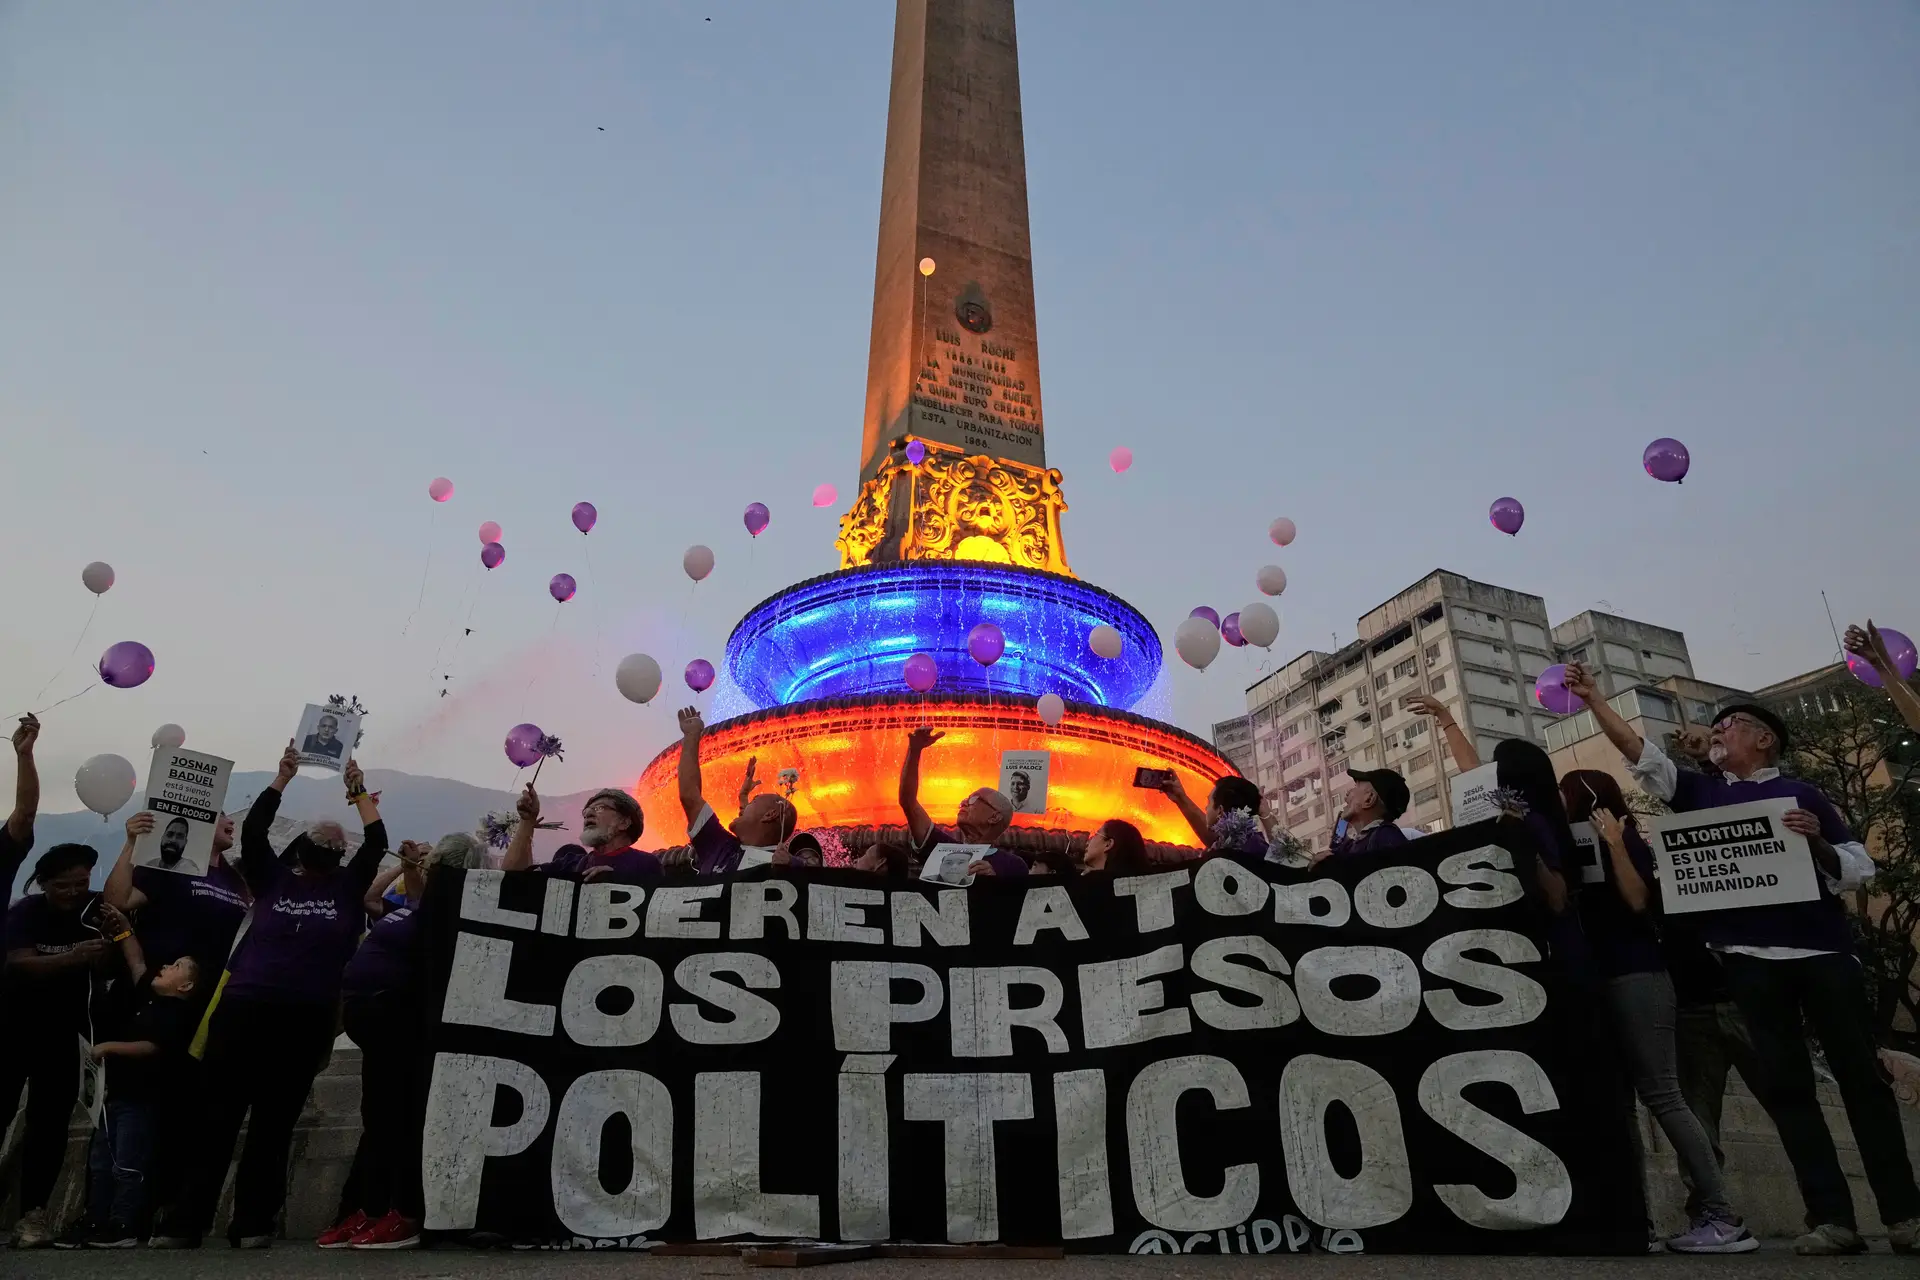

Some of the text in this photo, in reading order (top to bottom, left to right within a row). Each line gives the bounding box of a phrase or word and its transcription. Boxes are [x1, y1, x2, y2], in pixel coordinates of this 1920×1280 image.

[936, 329, 1016, 362] LUIS ROCHE
[949, 376, 992, 397] DISTRITO
[952, 366, 1025, 391] MUNICIPALIDAD
[929, 383, 957, 401] QUIEN
[963, 396, 988, 409] SUPO
[994, 402, 1025, 417] CREAR
[1031, 409, 1038, 421] Y
[922, 411, 1033, 446] ESTA URBANIZACION
[978, 412, 1003, 427] PARA
[1010, 418, 1040, 435] TODOS
[171, 756, 218, 774] JOSNAR
[169, 768, 214, 787] BADUEL
[162, 789, 211, 808] torturado
[165, 781, 211, 798] está siendo
[1462, 792, 1487, 806] ARMAS
[1463, 785, 1484, 798] JESÚS
[156, 801, 211, 820] EN EL RODEO
[1665, 821, 1768, 847] LA TORTURA
[1671, 840, 1786, 866] ES UN CRIMEN
[1674, 862, 1741, 881] DE LESA
[460, 844, 1525, 947] LIBEREN A TODOS
[1676, 873, 1779, 896] HUMANIDAD
[441, 928, 1548, 1058] LOS PRESOS
[422, 1049, 1573, 1242] POLÍTICOS
